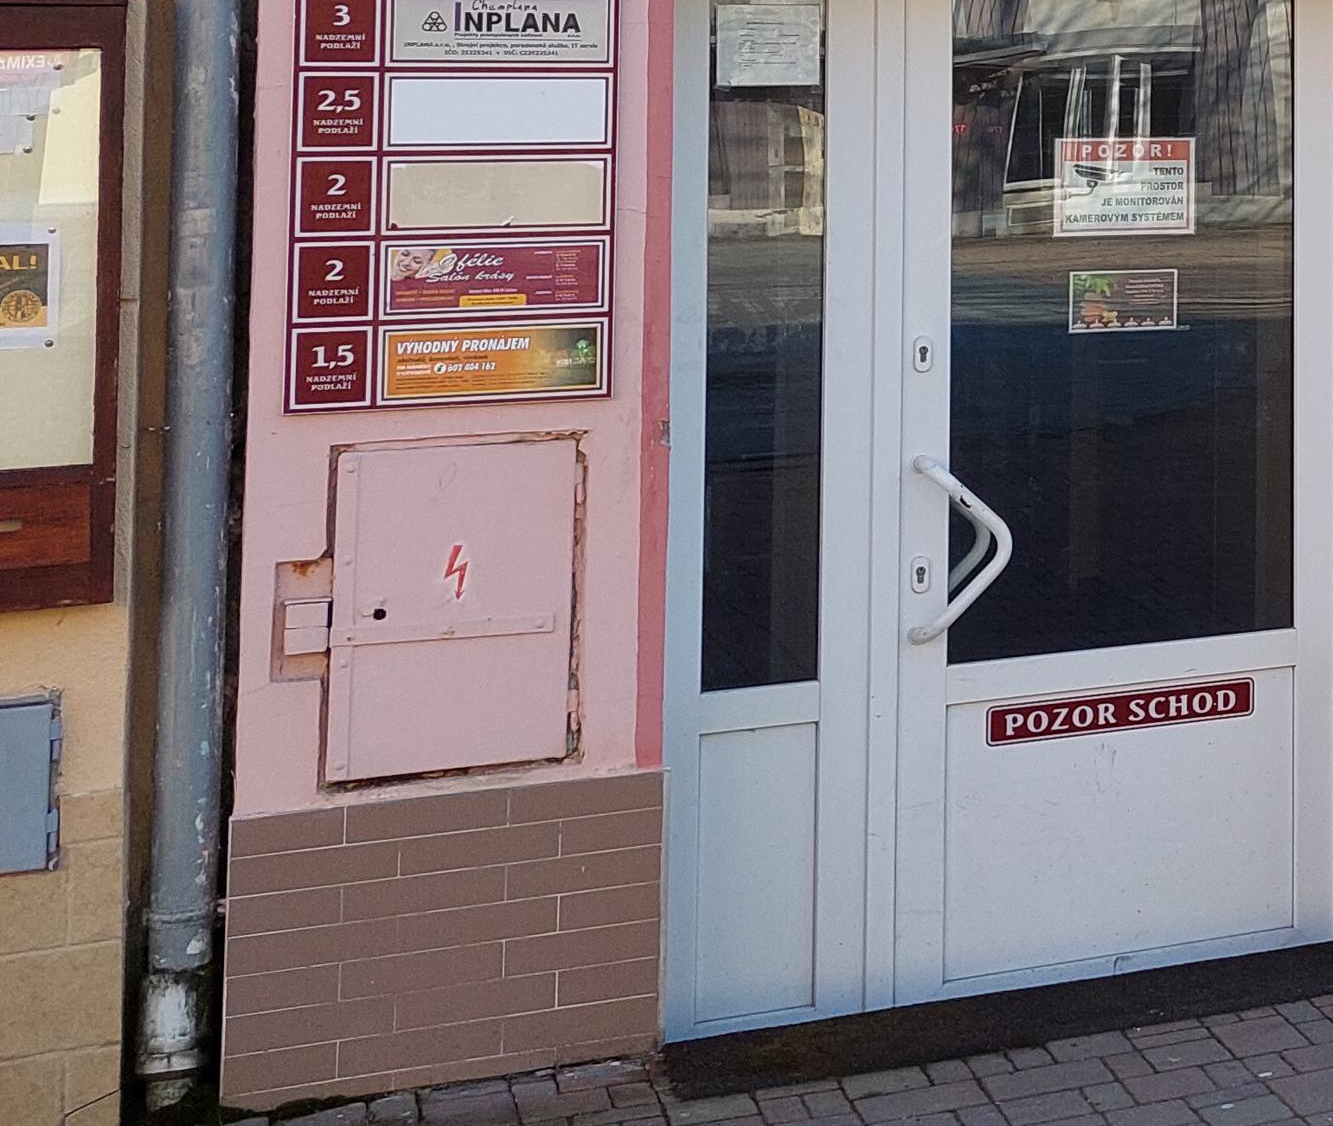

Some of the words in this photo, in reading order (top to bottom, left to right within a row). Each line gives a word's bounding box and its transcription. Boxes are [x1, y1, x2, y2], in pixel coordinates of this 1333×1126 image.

[332, 5, 351, 26] 3
[454, 2, 582, 32] INPLANA
[315, 32, 367, 42] NADZEMNÍ
[320, 41, 361, 50] PODLAŽÍ
[317, 89, 361, 113] 2,5
[312, 117, 364, 127] NADZEMNÍ
[318, 126, 359, 135] PODLAŽÍ
[1081, 144, 1173, 158] POZOR!
[1153, 167, 1184, 176] TENTO
[326, 174, 347, 196] 2
[1141, 181, 1184, 191] PROSTOR
[1101, 198, 1113, 207] JE
[1115, 196, 1184, 206] MONITOROVÁN
[311, 202, 361, 212] NADZEMNÍ
[315, 210, 357, 219] PODLAŽÍ
[1065, 213, 1129, 223] KAMEROVÝM
[1131, 212, 1184, 222] SYSTÉMEM
[324, 260, 345, 281] 2
[308, 287, 359, 297] NADZEMNÍ
[313, 295, 354, 305] PODLAŽÍ
[397, 337, 460, 355] VÝHODNÝ
[461, 335, 529, 353] PRONÁJEM
[312, 344, 355, 368] 1,5
[306, 373, 357, 382] NADZEMNÍ
[311, 382, 352, 391] PODLAŽÍ
[1004, 702, 1117, 736] POZOR
[1128, 689, 1237, 722] SCHOD
